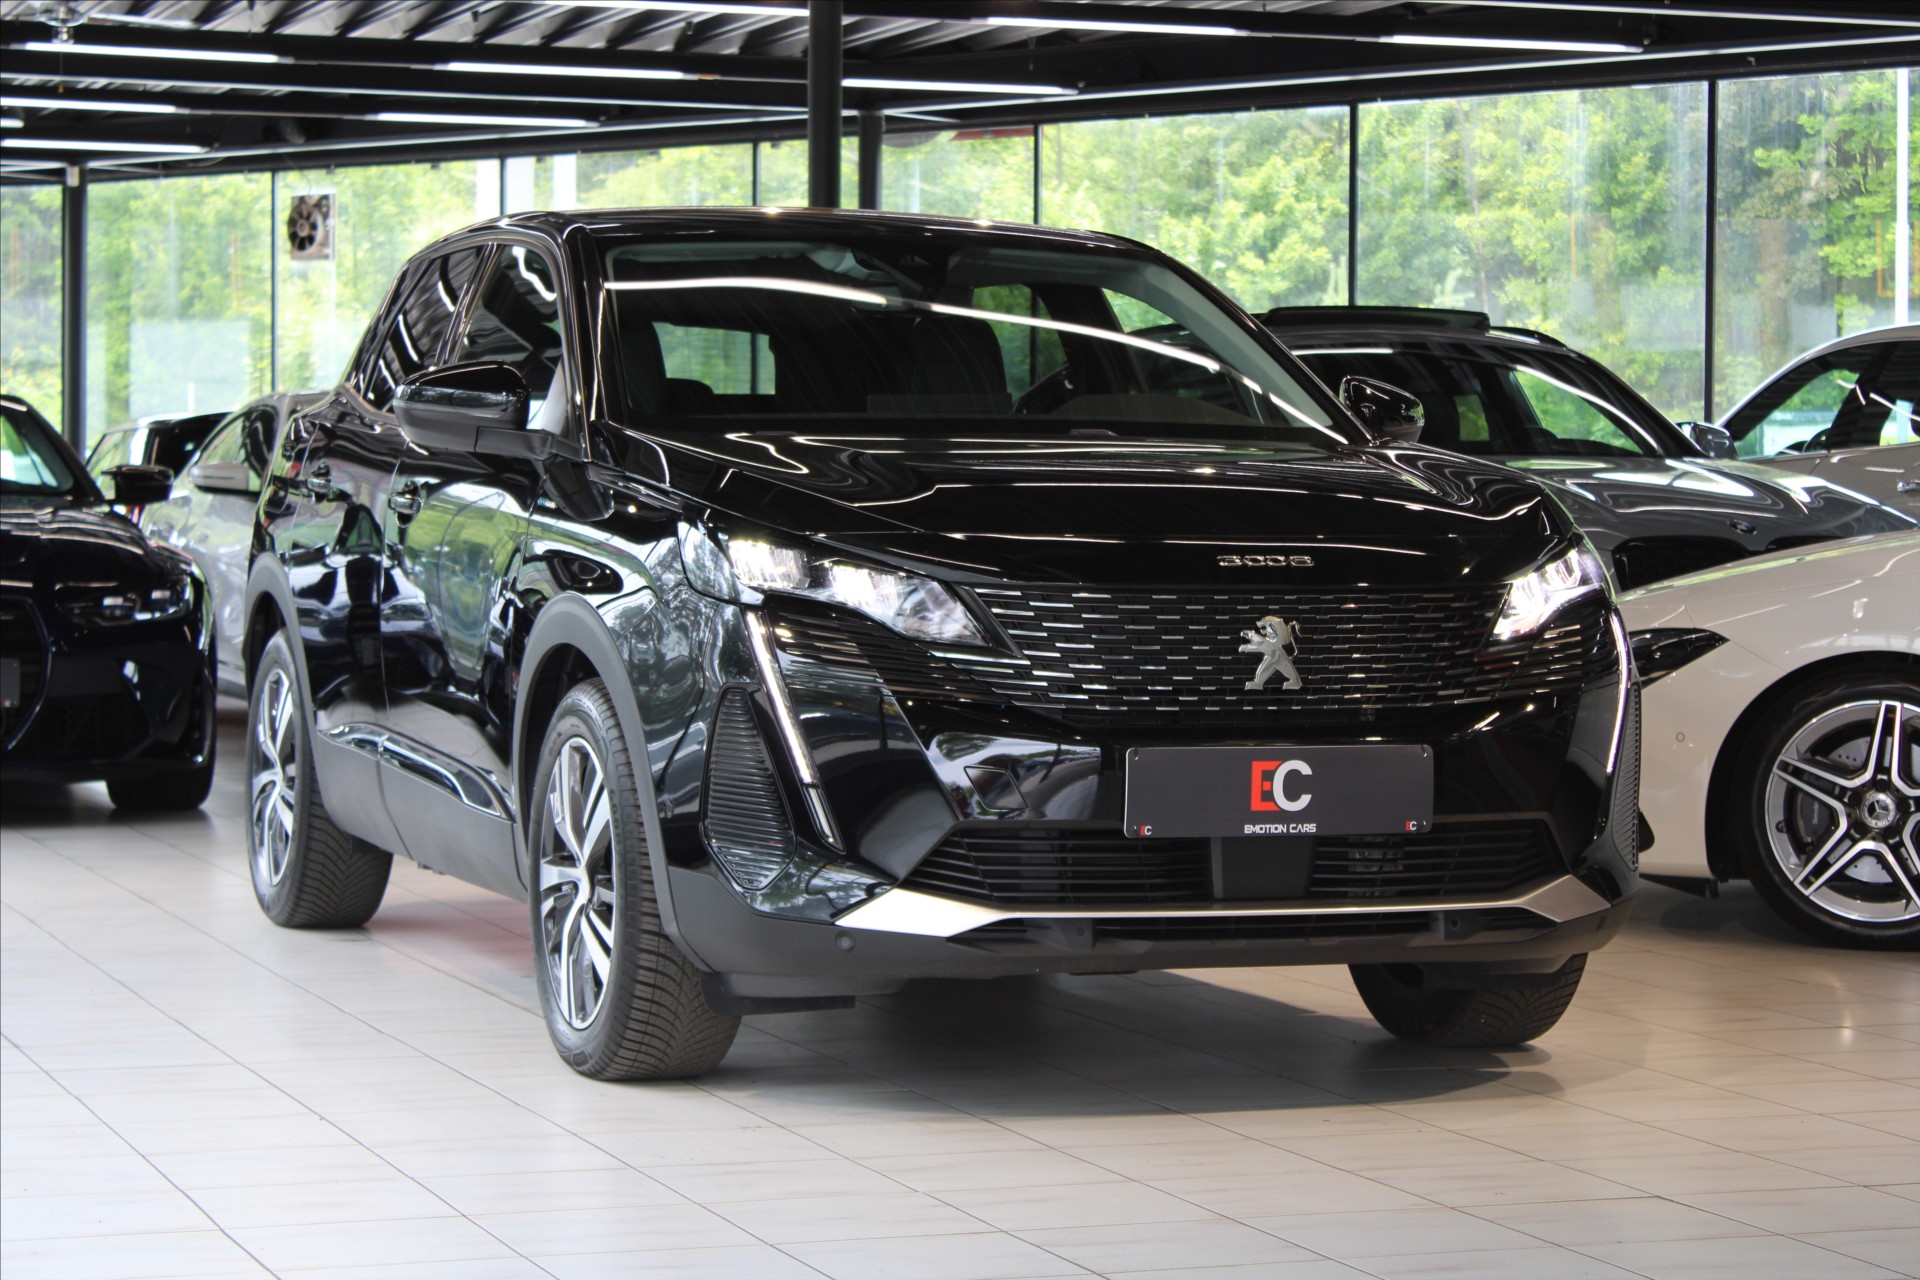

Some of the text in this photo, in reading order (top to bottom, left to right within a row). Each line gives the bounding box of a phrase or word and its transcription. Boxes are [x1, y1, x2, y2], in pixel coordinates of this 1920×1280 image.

[1217, 555, 1315, 567] 3008
[1251, 760, 1313, 811] EC
[1244, 823, 1317, 834] EMOTION CARS
